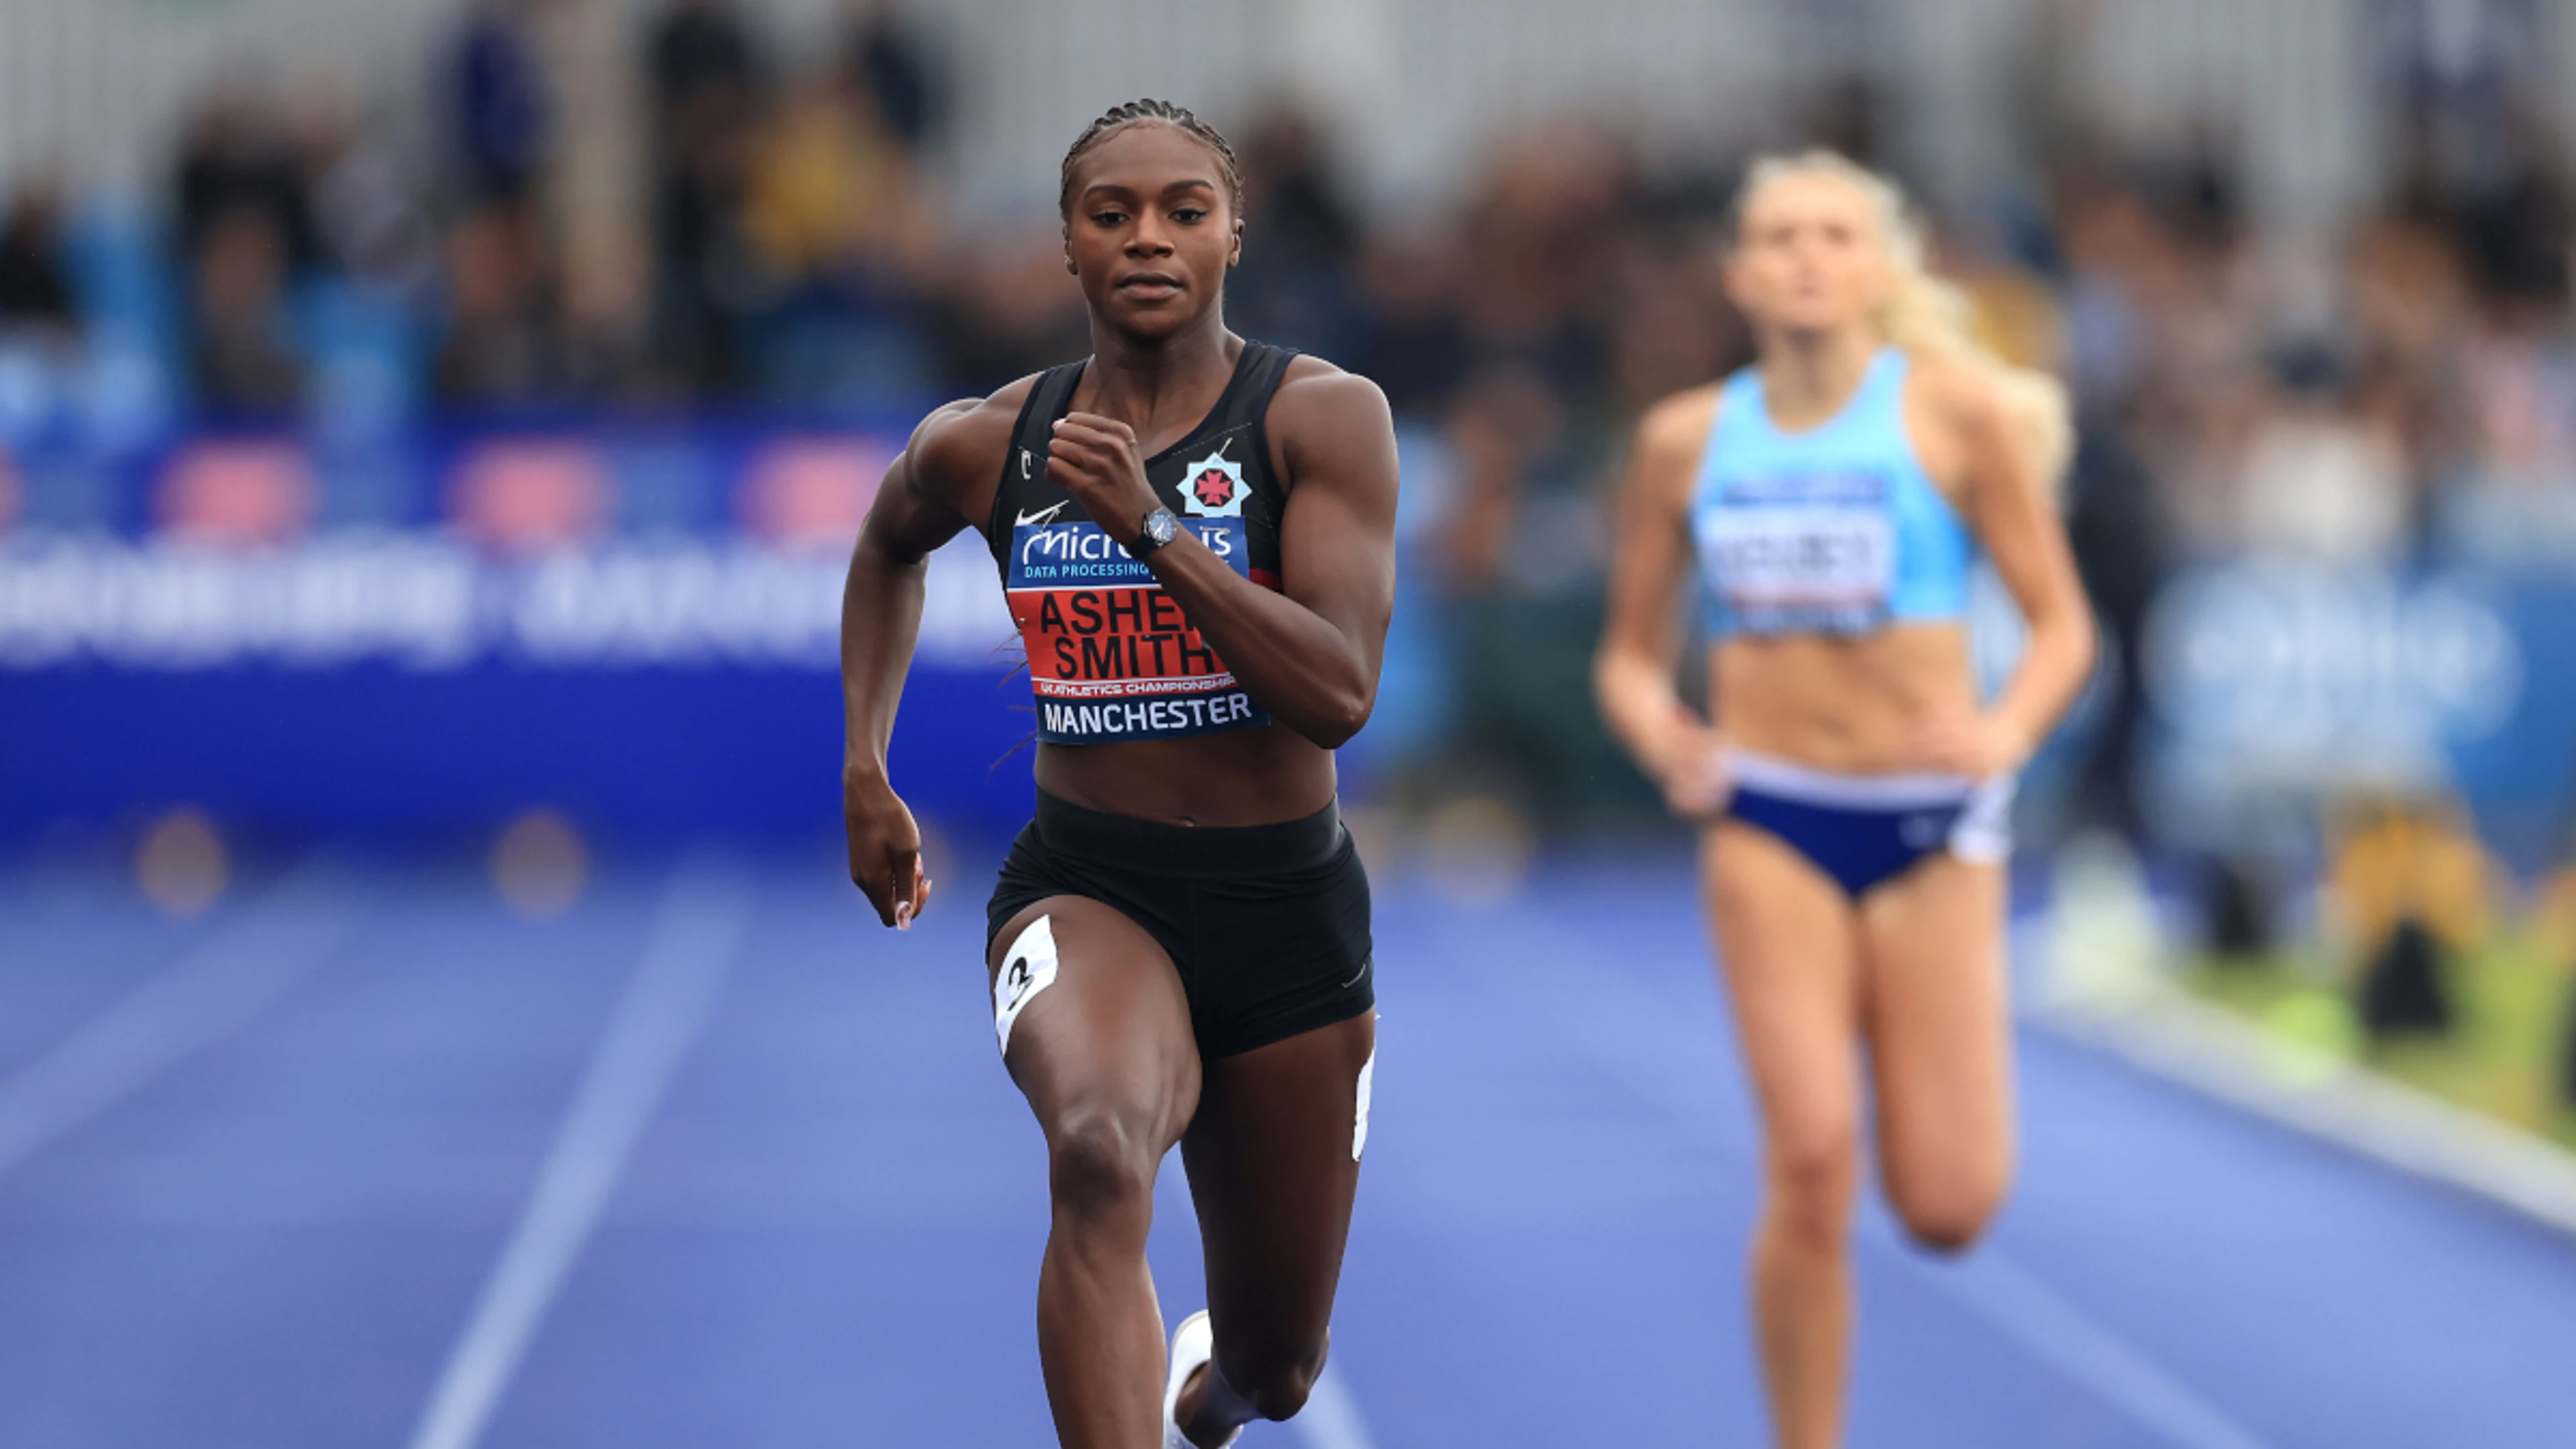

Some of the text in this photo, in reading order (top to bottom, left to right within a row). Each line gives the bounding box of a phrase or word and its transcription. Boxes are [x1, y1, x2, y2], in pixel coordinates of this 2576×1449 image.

[1024, 562, 1149, 578] DATA PROCESSING
[1040, 590, 1194, 635] ASHE
[1056, 634, 1214, 679] SMITH
[1053, 684, 1123, 696] ATHLETICS
[1044, 693, 1252, 735] MANCHESTER
